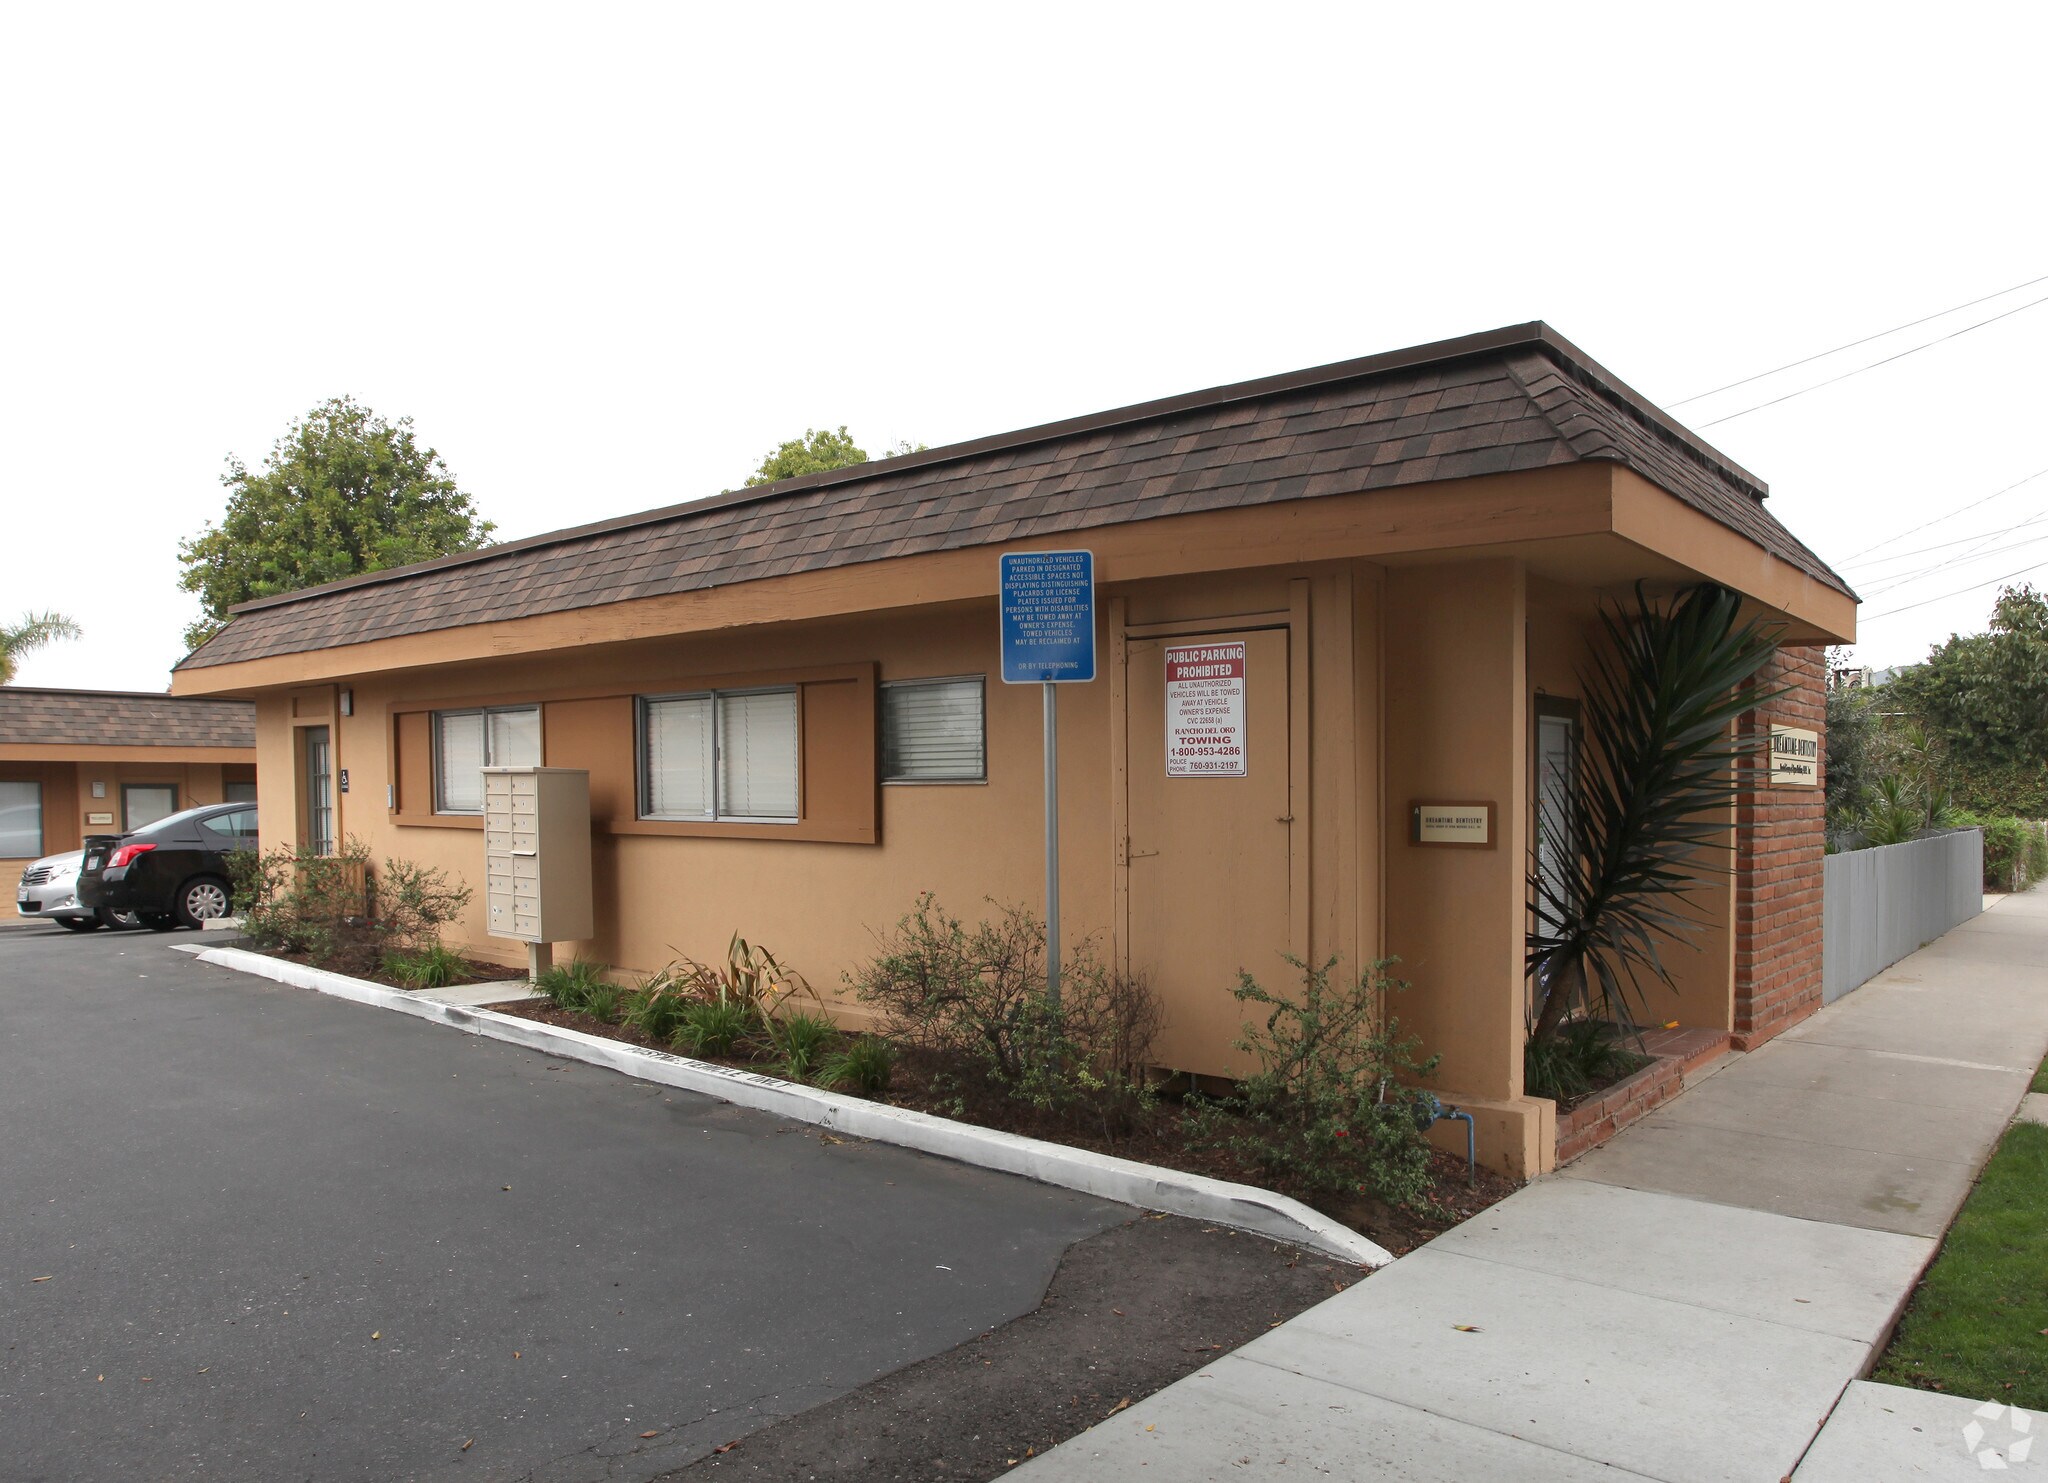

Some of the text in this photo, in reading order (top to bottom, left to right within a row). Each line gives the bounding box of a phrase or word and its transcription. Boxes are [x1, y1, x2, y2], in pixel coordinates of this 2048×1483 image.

[1009, 557, 1053, 565] UNAUTHORIZED
[1168, 647, 1242, 663] PUBLIC PARKING
[1177, 664, 1232, 678] PROHIBITED
[1189, 680, 1231, 688] UNAUTHORIZED
[1171, 747, 1240, 756] 1-800-953-4286
